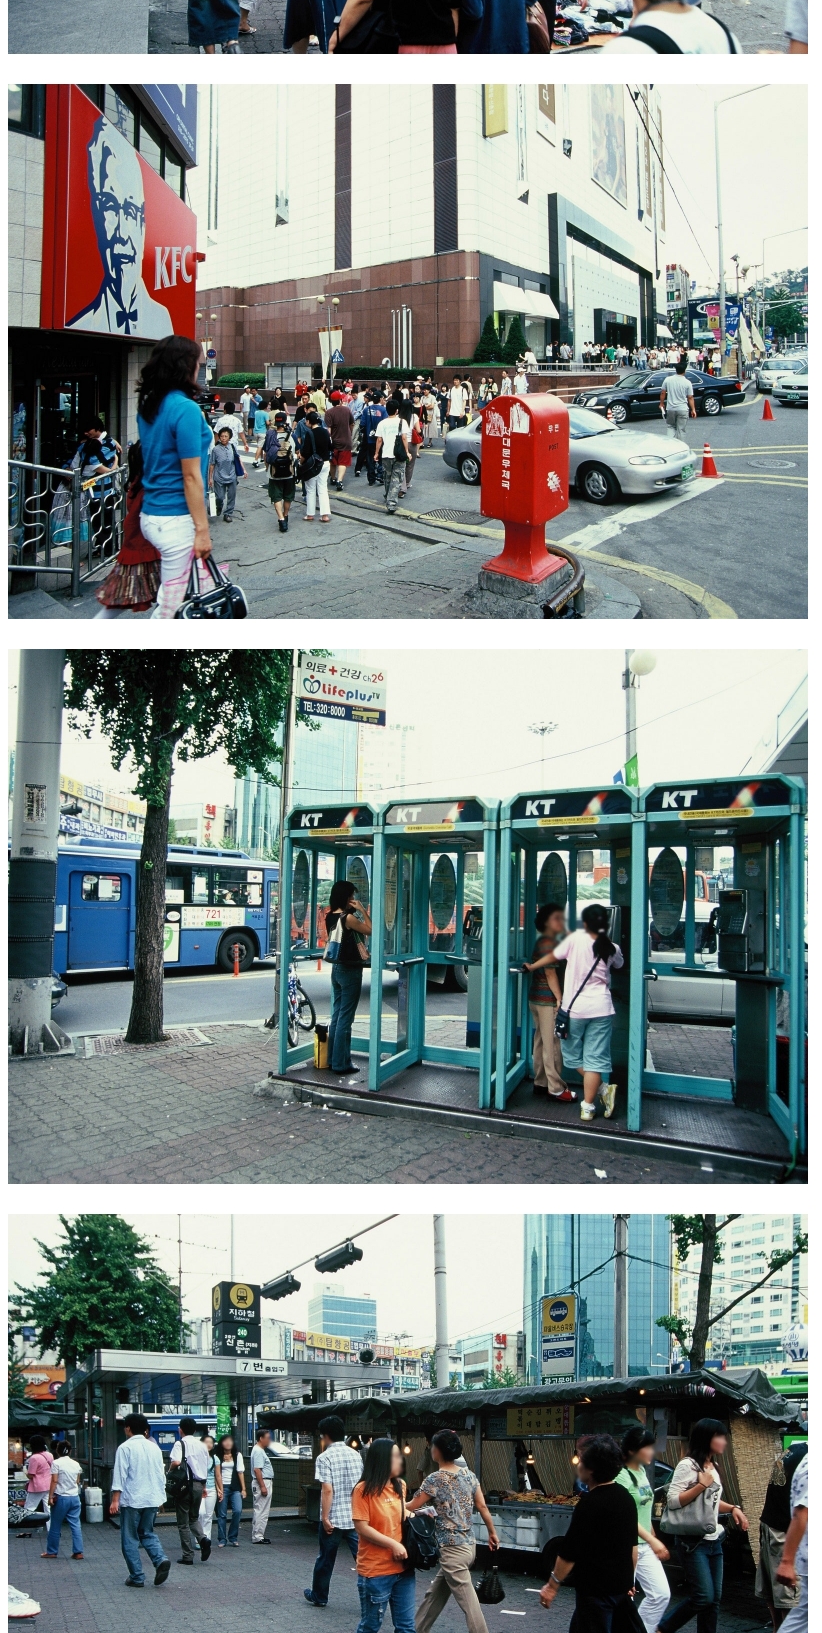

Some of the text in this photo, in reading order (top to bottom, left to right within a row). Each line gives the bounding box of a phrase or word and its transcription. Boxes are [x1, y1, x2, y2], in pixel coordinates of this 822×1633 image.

[154, 245, 193, 291] KFC
[548, 443, 560, 452] POST
[306, 661, 328, 674] 의료
[340, 667, 362, 680] 건강
[372, 691, 381, 700] TV
[662, 789, 698, 809] KT
[526, 799, 556, 816] KT
[300, 813, 323, 827] KT
[396, 807, 422, 823] KT
[206, 909, 222, 919] 721
[229, 1309, 255, 1318] 지하철
[226, 1339, 245, 1347] 신촌
[254, 1363, 264, 1372] 번
